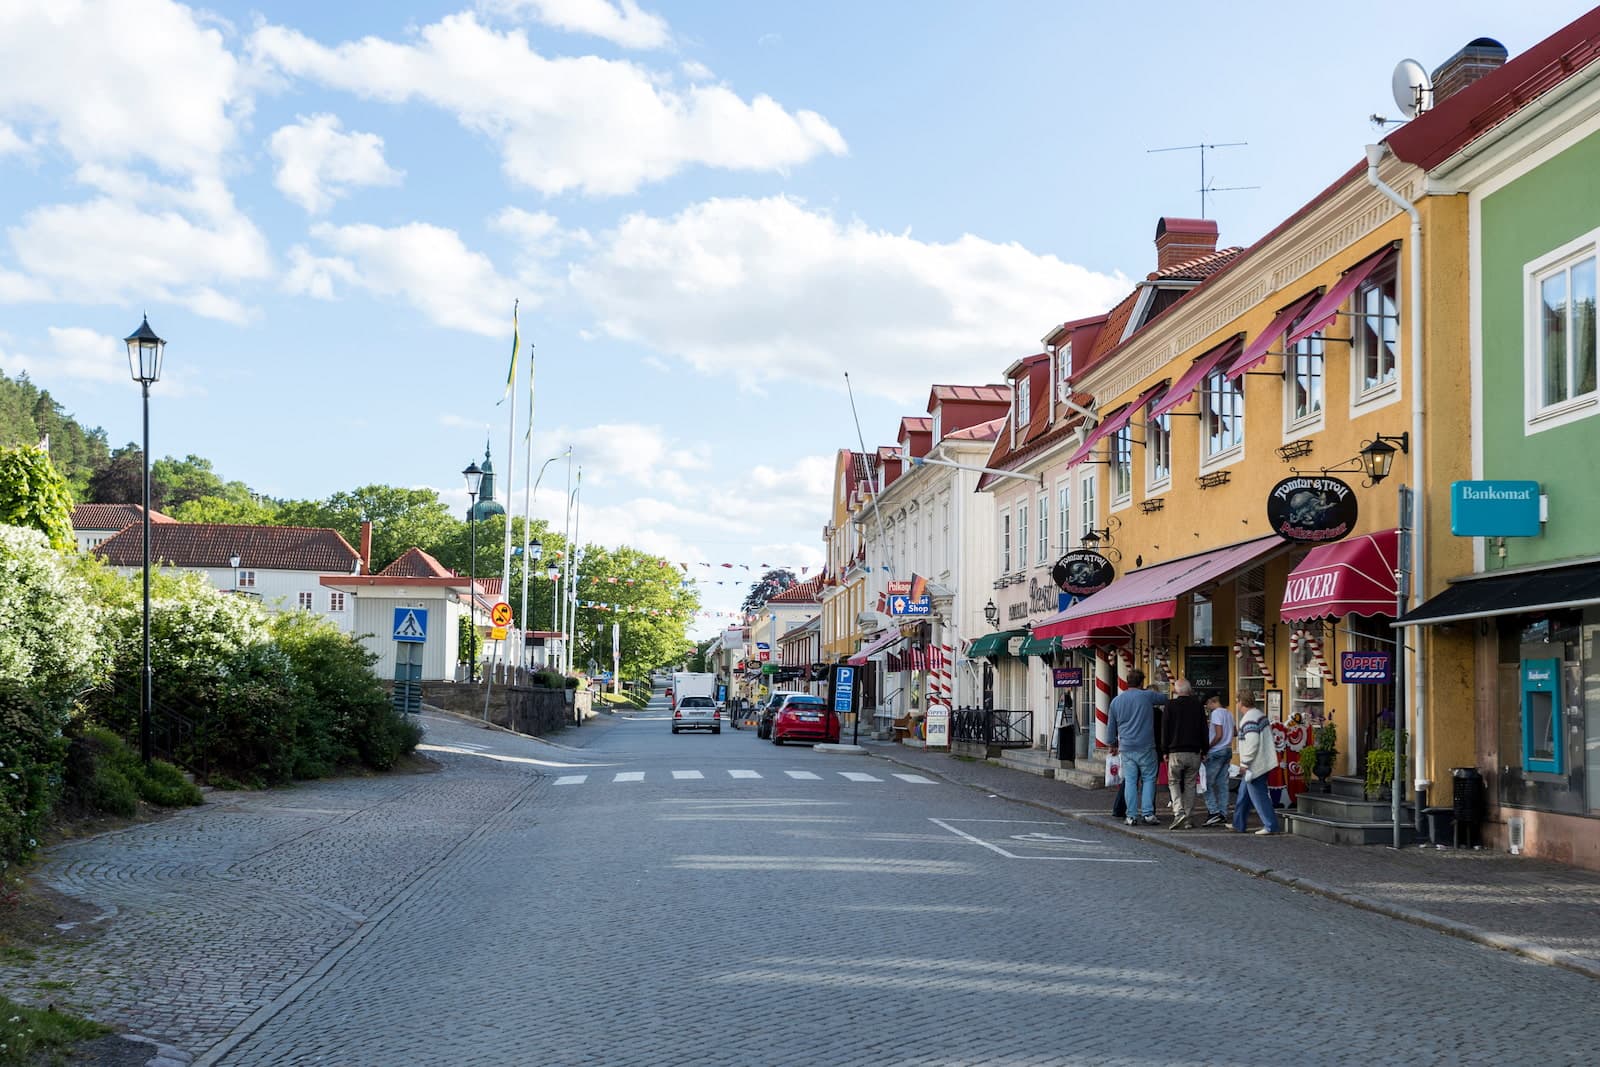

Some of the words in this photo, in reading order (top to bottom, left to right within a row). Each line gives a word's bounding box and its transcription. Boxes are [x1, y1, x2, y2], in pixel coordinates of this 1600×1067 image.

[1321, 480, 1349, 502] Troll
[1462, 486, 1531, 500] Bankomat
[1282, 571, 1340, 603] KOKERI
[908, 604, 929, 614] Shop
[1343, 654, 1388, 670] ÖPPET
[841, 670, 850, 682] P
